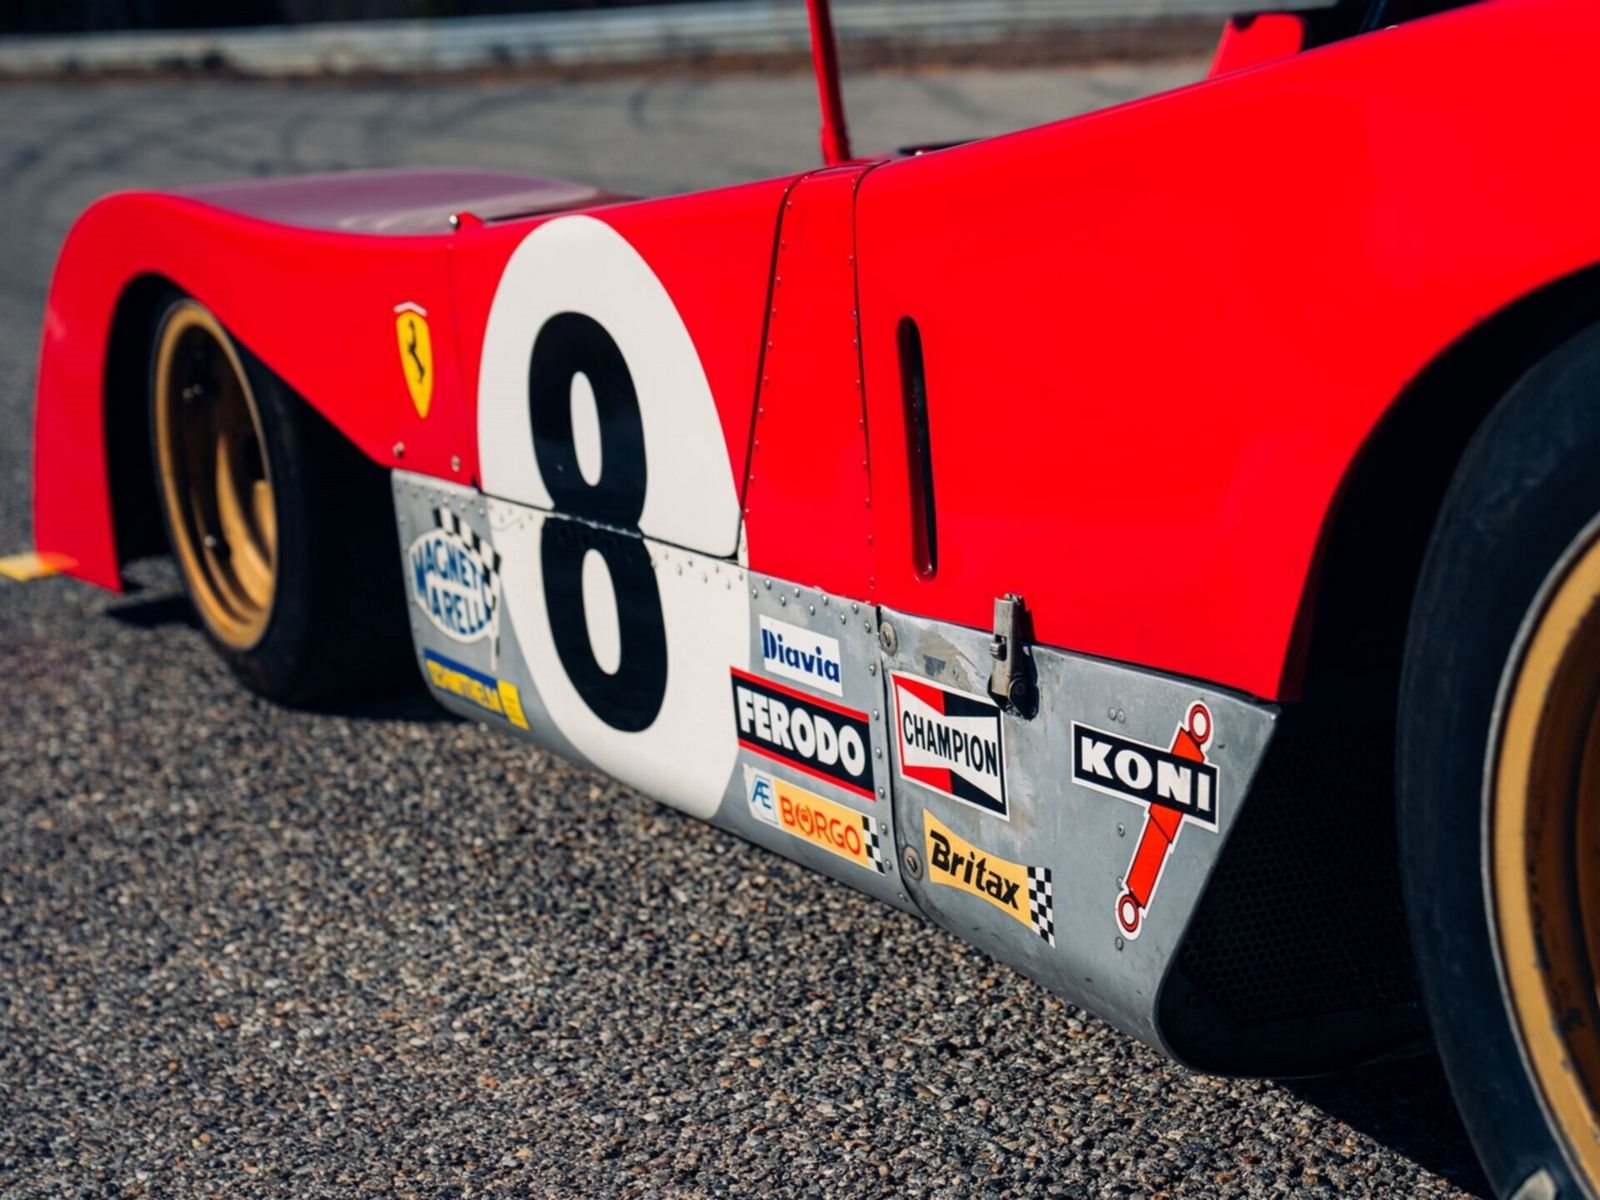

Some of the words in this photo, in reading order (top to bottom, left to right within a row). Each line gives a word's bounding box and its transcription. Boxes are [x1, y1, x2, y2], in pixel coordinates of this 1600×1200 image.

[528, 311, 667, 733] 8
[762, 629, 840, 683] Diavia
[737, 686, 866, 777] FERODO
[902, 710, 999, 777] CHAMPION
[1081, 736, 1211, 812] KONI
[779, 796, 861, 856] BORGO
[929, 829, 1021, 910] Britax
